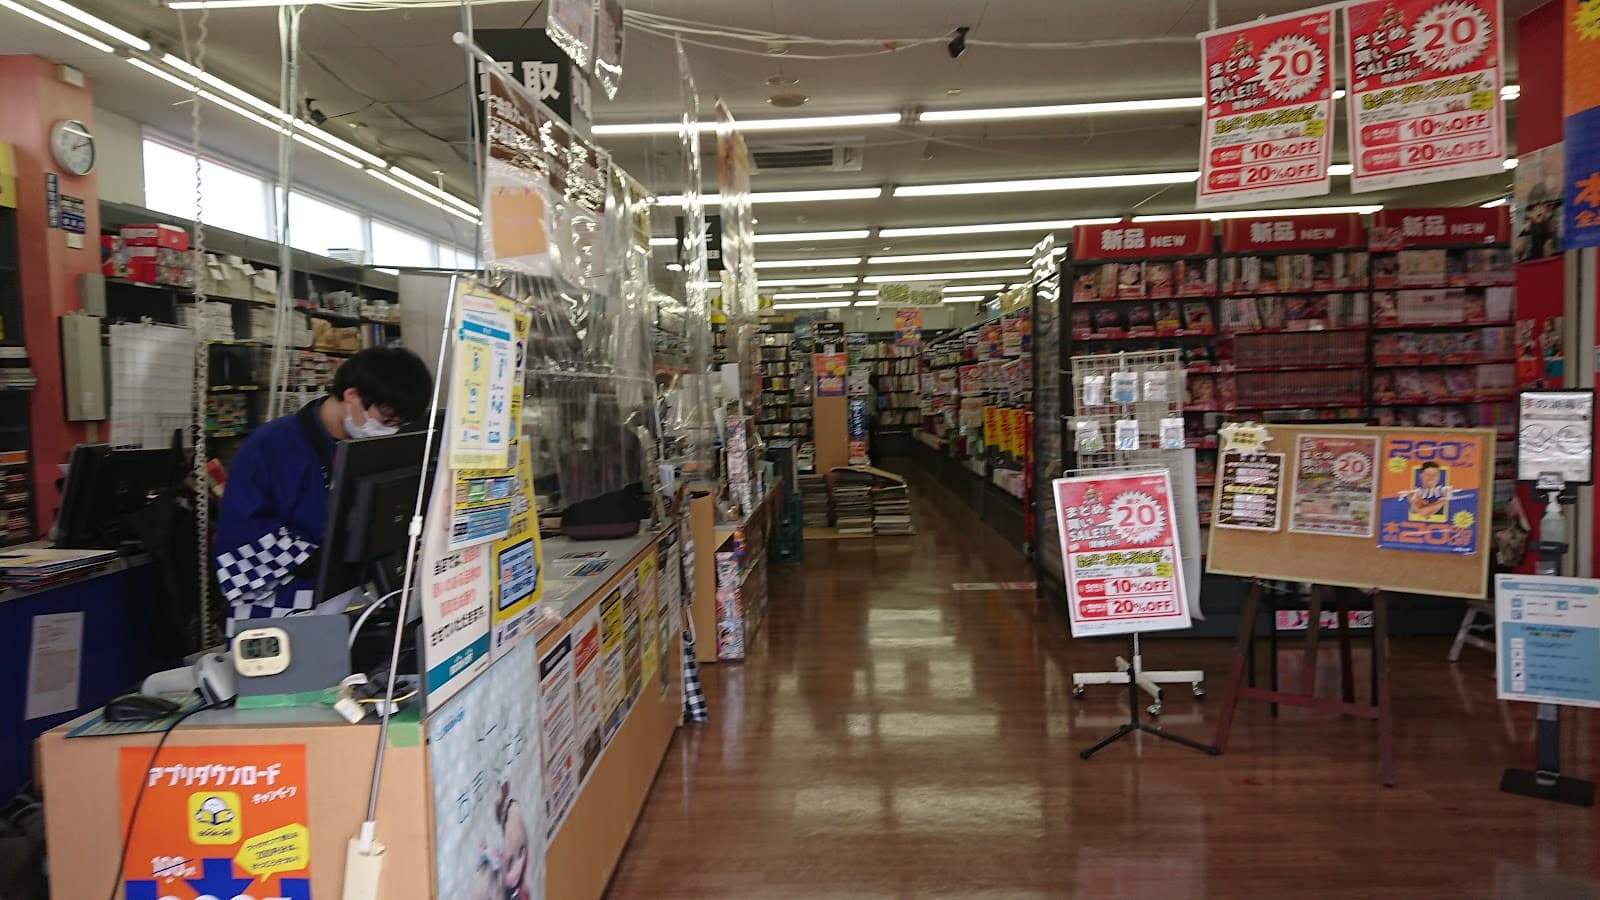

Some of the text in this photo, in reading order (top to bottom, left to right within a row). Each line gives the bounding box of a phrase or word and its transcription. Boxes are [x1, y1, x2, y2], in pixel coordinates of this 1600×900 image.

[1354, 24, 1407, 49] まとめ
[1424, 17, 1476, 51] 20
[1209, 55, 1255, 77] まとめ
[1268, 50, 1313, 81] 20
[1356, 54, 1411, 80] SALE!!
[1211, 82, 1258, 104] SALE!!
[1408, 114, 1488, 137] 10%OFF
[1251, 140, 1318, 160] 10%OFF
[1407, 139, 1488, 163] 20%OFF
[1247, 164, 1315, 183] 20%OFF
[1250, 221, 1337, 243] 新品 NEW
[1402, 215, 1486, 237] 新品 NEW
[1101, 228, 1186, 251] 新品 NEW
[1340, 460, 1366, 474] 20
[1065, 504, 1106, 518] まとめ
[1117, 504, 1156, 527] 20
[1068, 525, 1113, 541] SALE!!
[1112, 579, 1170, 594] 10%OFF
[1113, 599, 1172, 614] 20%OFF
[148, 763, 281, 787] アプリダウンロード
